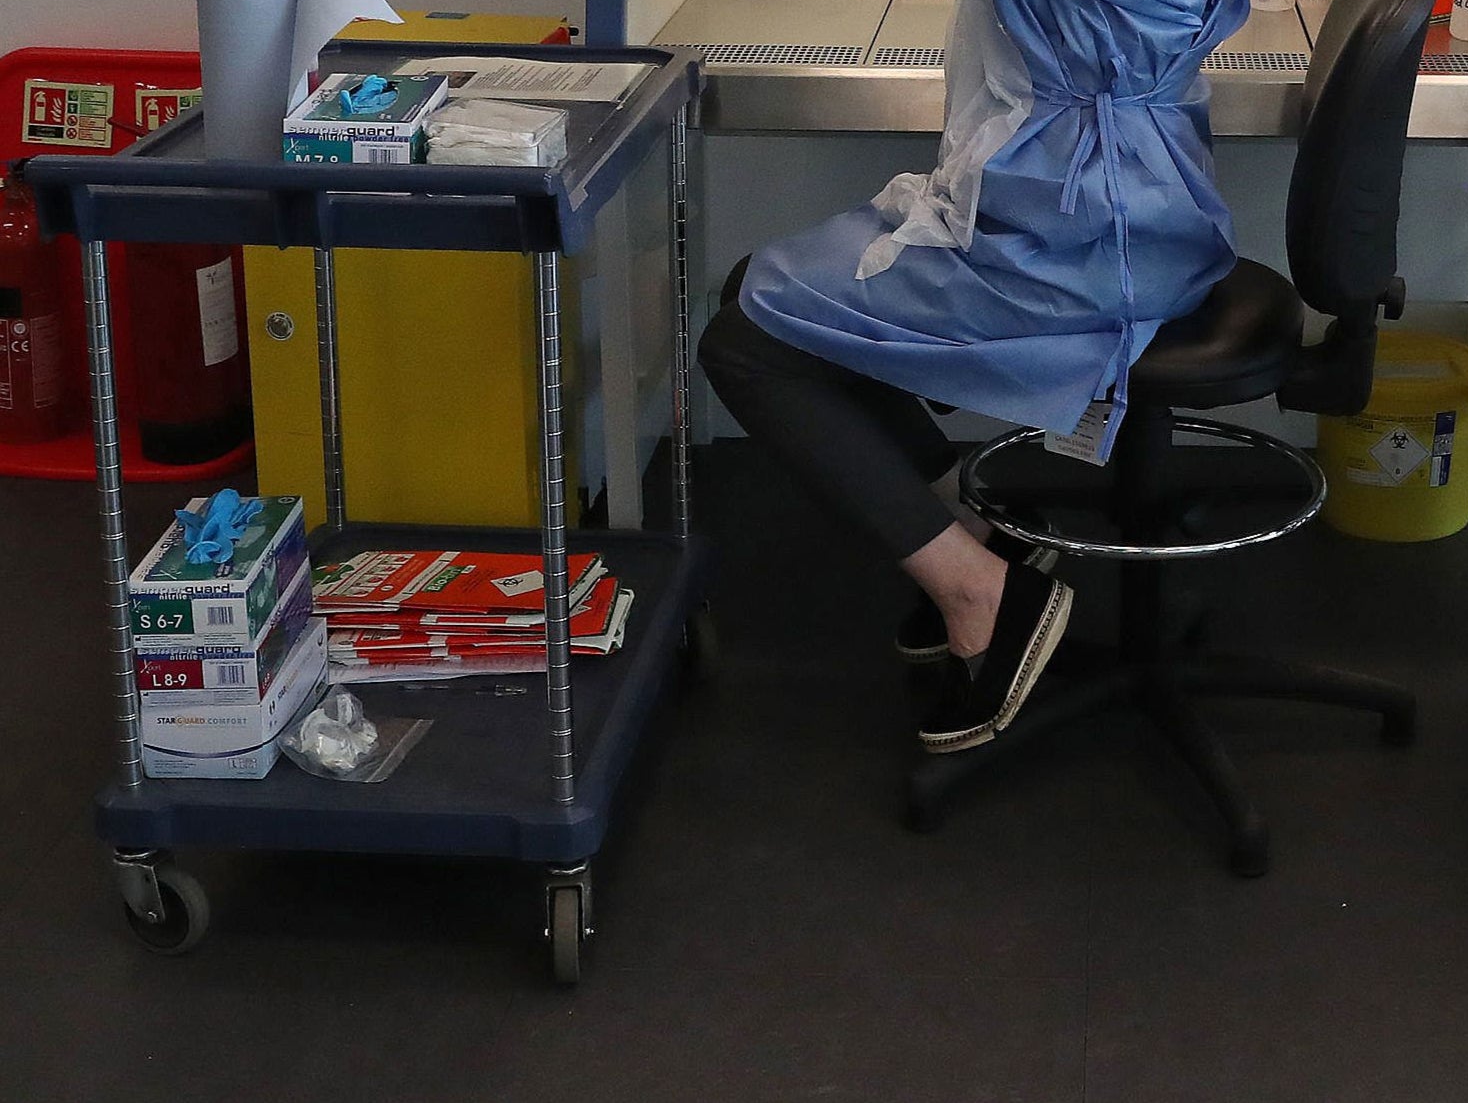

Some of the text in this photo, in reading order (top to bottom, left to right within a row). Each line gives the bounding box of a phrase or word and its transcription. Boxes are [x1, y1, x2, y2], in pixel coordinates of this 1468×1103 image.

[318, 133, 349, 142] nitrile
[158, 592, 188, 601] nitrile
[140, 614, 183, 629] S 6-7
[152, 674, 188, 686] L 8-9
[207, 717, 247, 725] COMFORT
